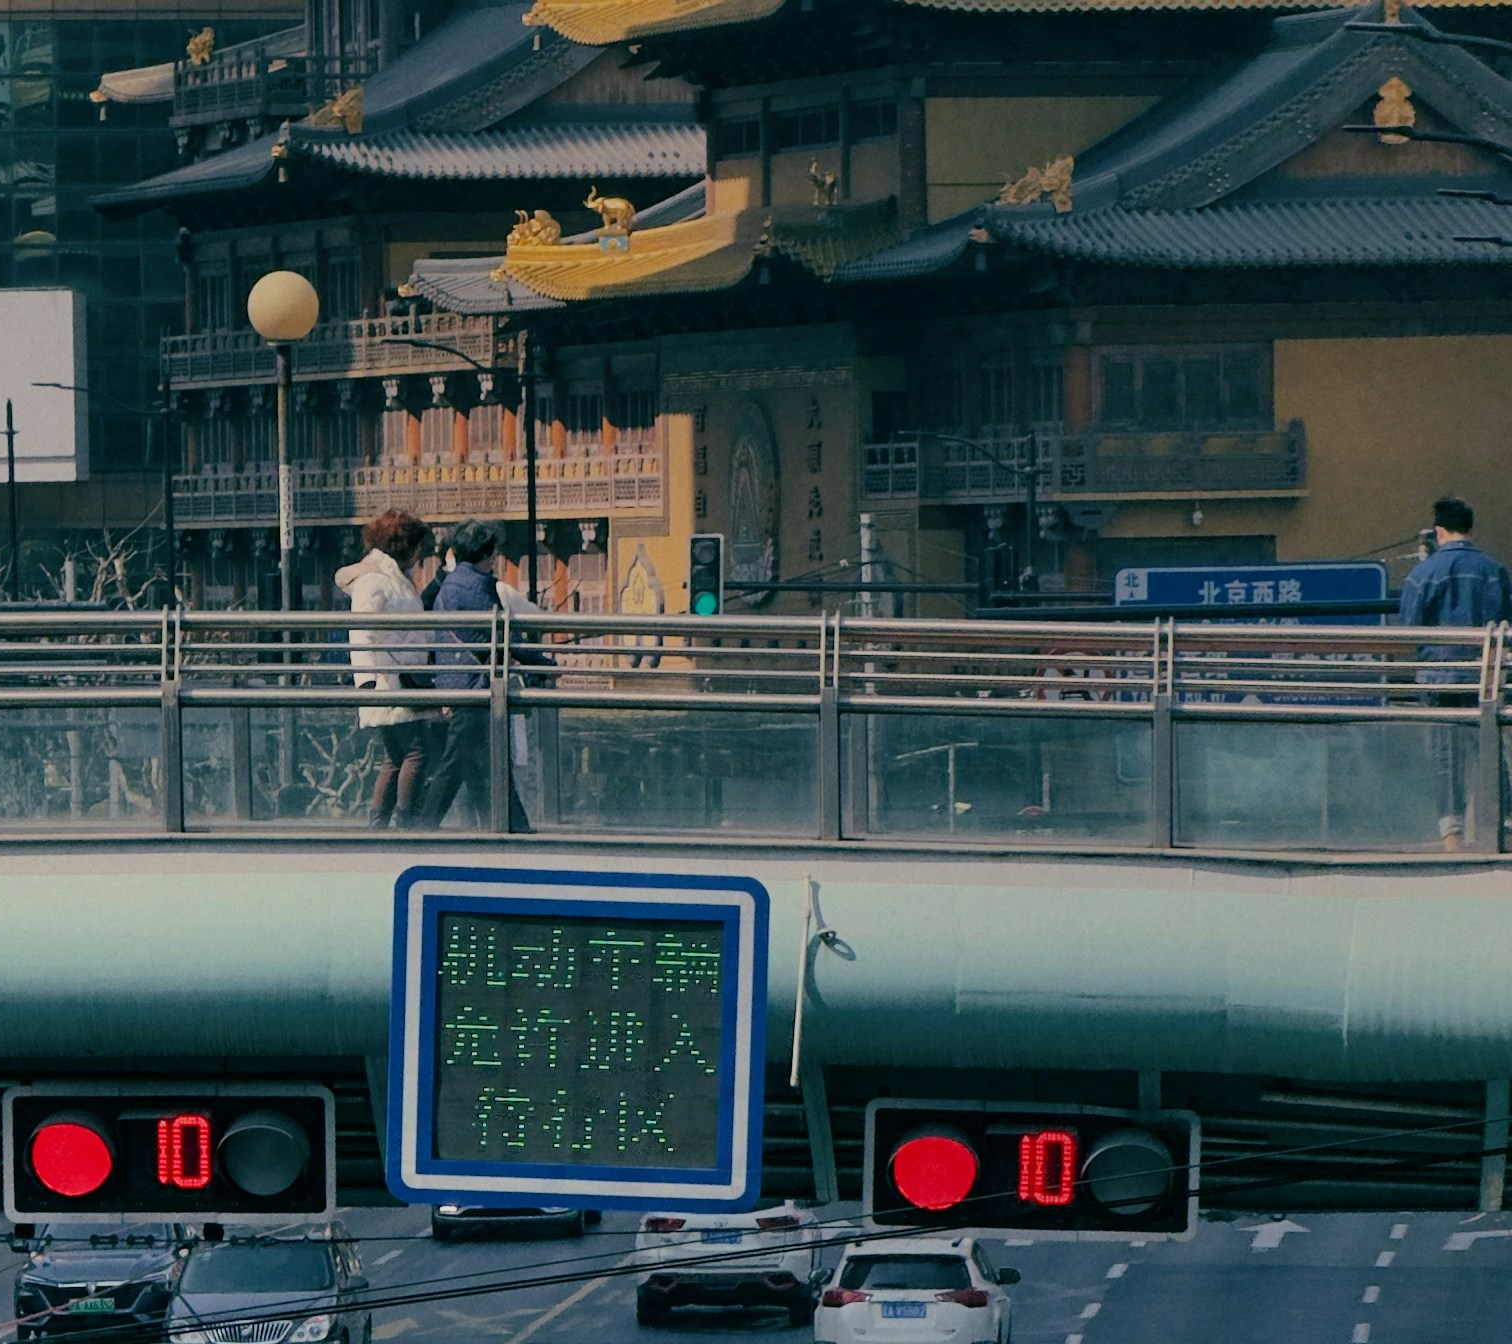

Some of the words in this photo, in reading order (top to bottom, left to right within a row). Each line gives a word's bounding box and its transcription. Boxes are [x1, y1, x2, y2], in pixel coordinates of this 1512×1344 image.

[1125, 573, 1139, 588] 北
[1198, 580, 1302, 603] 北京西路
[158, 1114, 211, 1189] 10
[1019, 1131, 1078, 1206] 10
